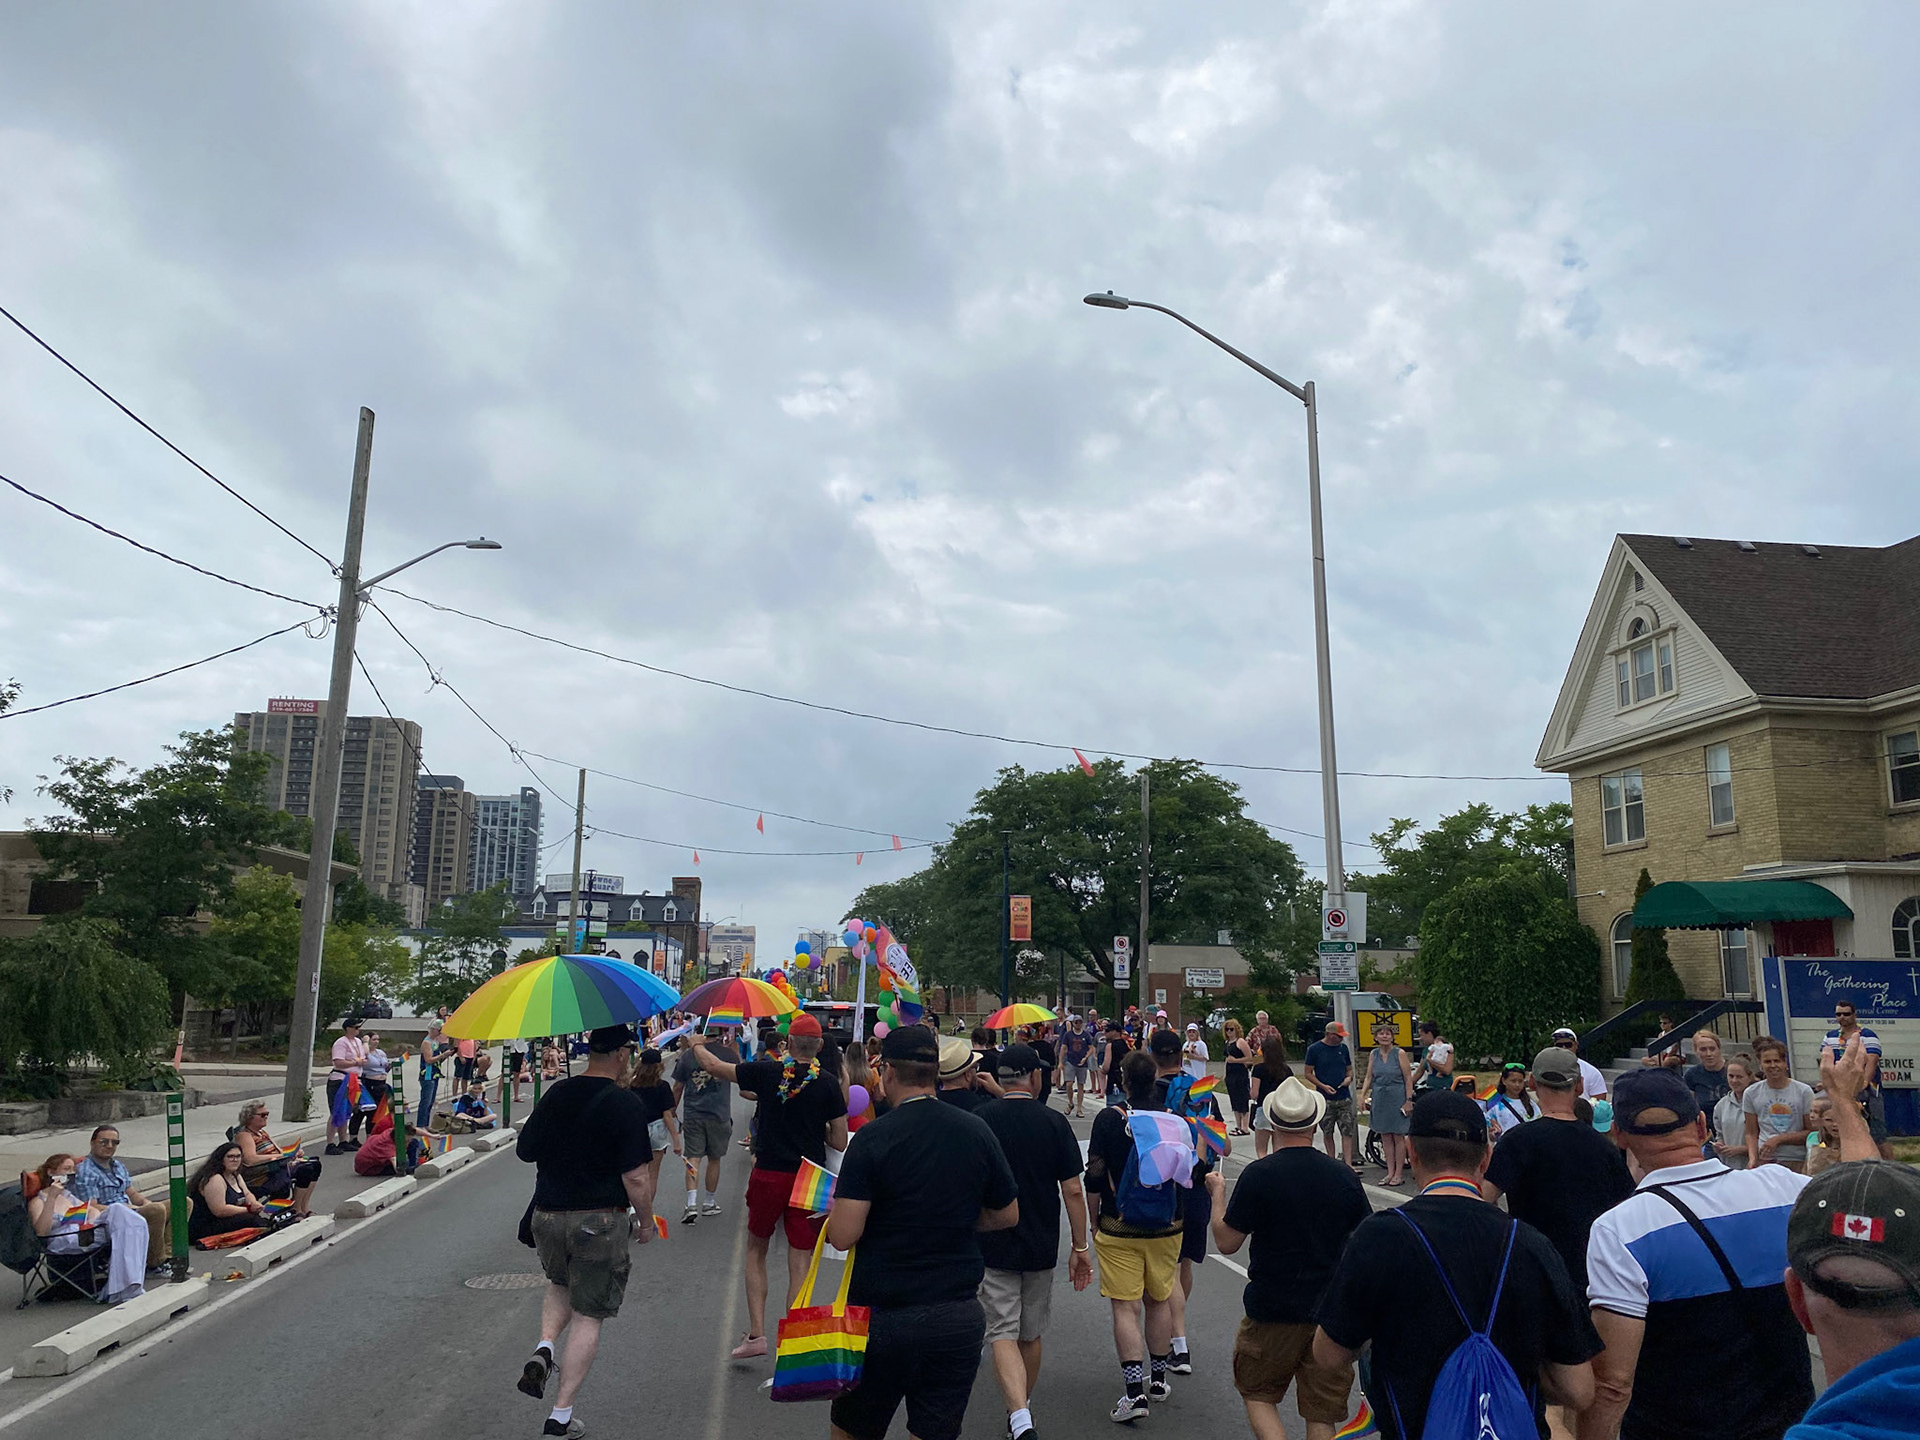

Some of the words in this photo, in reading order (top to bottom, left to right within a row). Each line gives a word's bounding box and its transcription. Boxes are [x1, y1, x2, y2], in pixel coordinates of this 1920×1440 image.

[1805, 962, 1830, 976] The
[1824, 975, 1890, 995] Gathering
[1870, 993, 1908, 1007] Place
[1879, 1058, 1915, 1069] ERVICE
